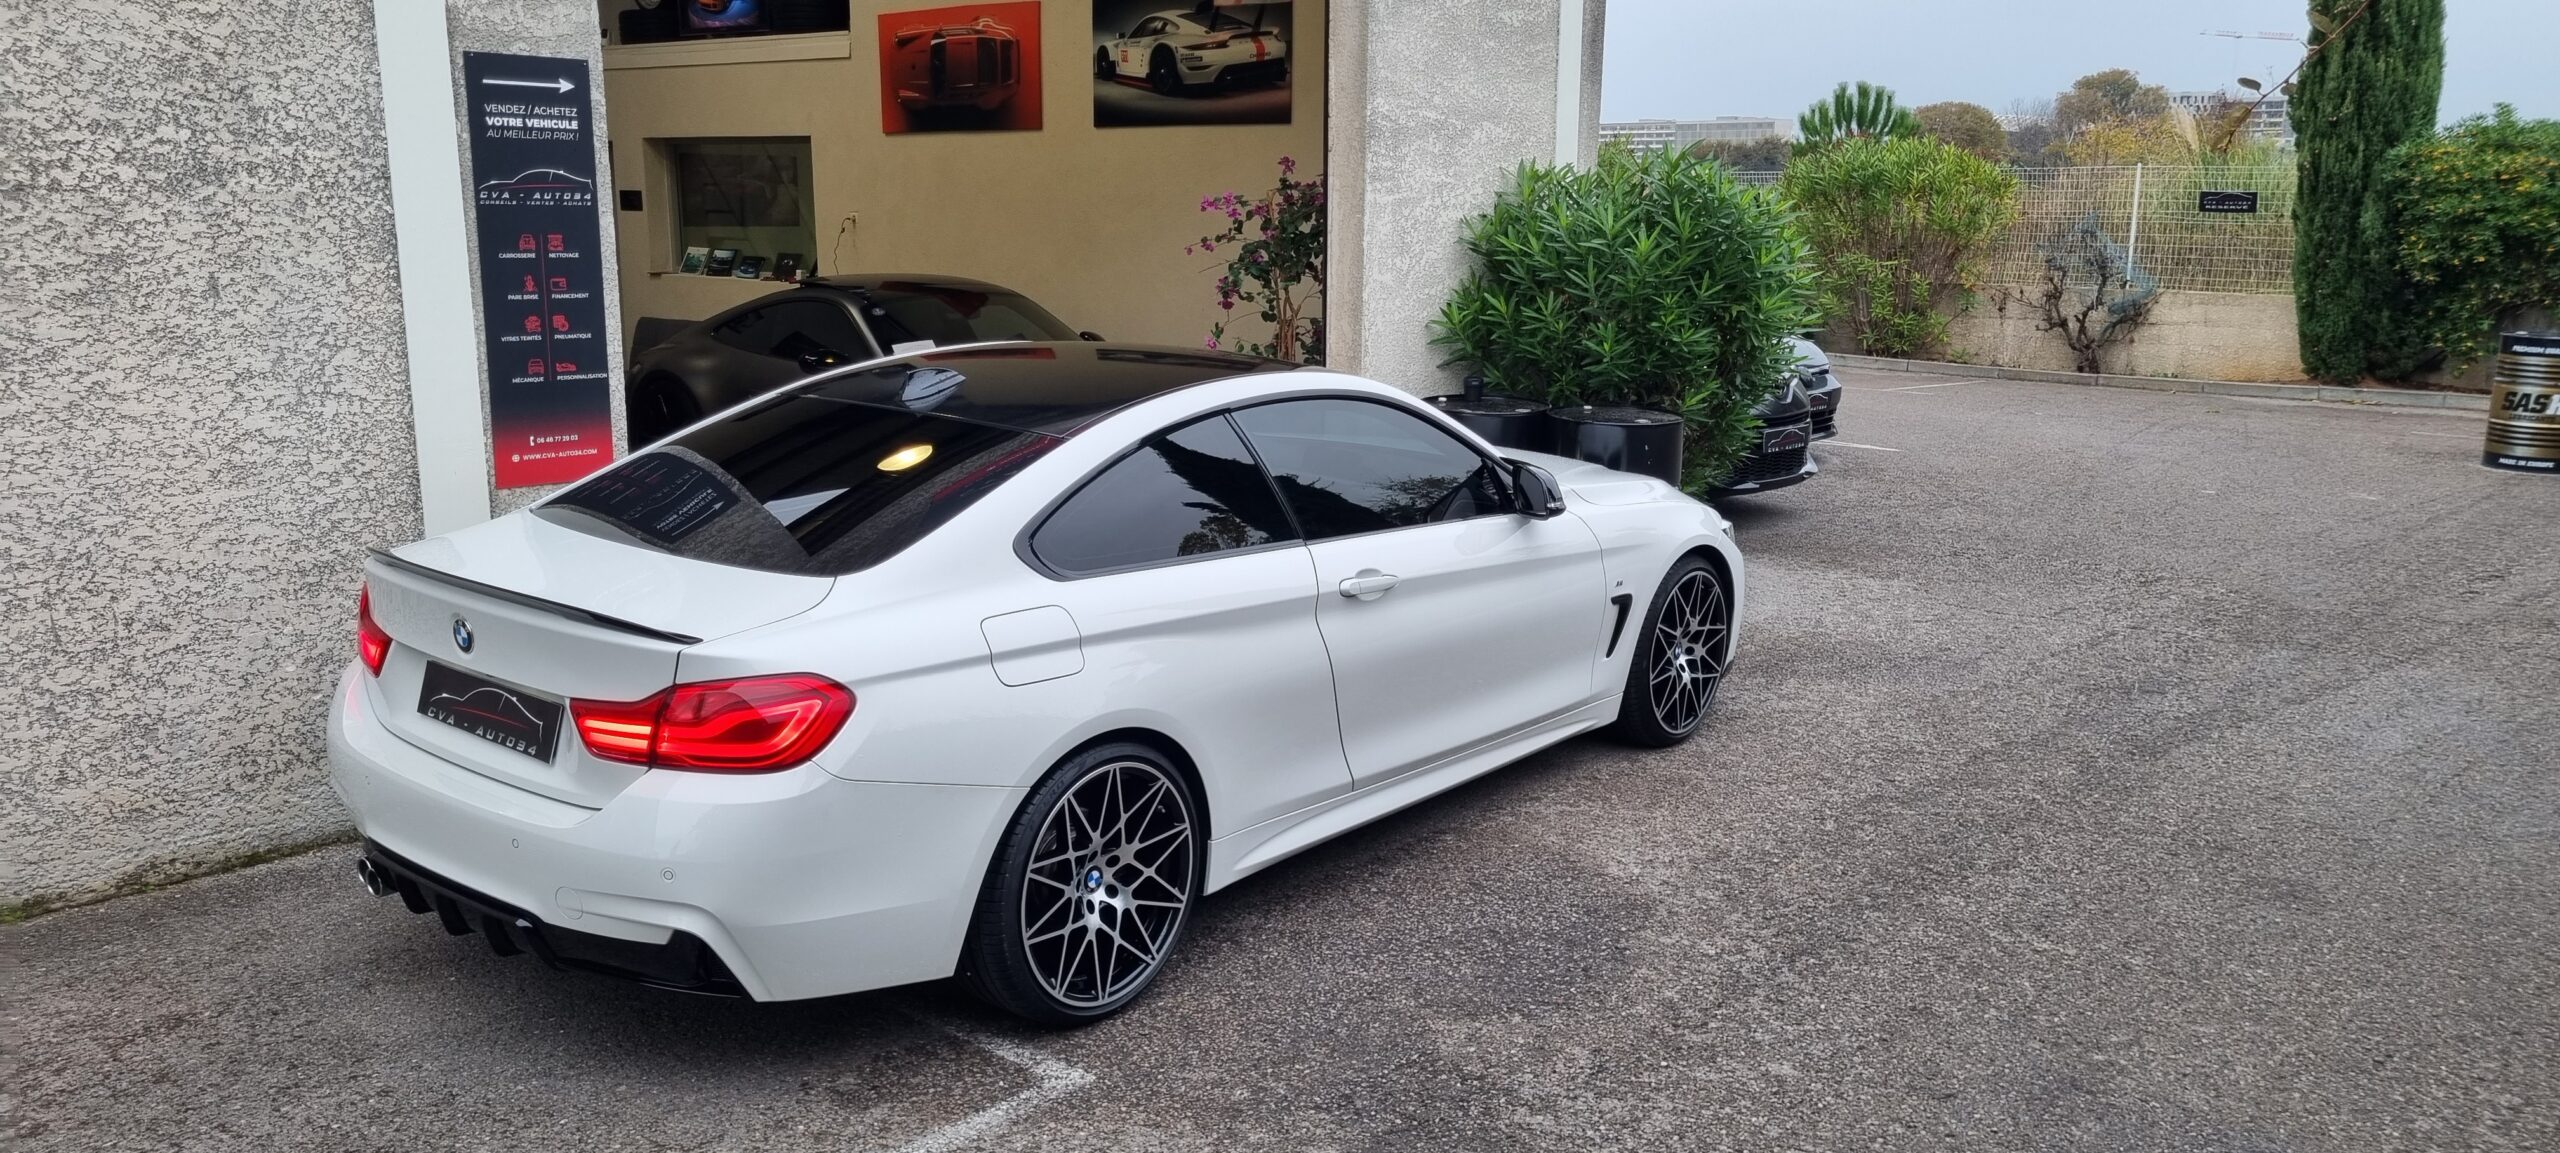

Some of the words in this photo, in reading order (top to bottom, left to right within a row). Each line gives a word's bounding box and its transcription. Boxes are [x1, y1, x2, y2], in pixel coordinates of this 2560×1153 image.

[484, 103, 526, 115] VENDEZ
[527, 104, 532, 115] /
[533, 106, 578, 117] ACHETEZ
[485, 116, 523, 127] VOTRE
[525, 118, 579, 130] VEHICULE
[486, 128, 501, 138] AU
[503, 129, 552, 140] MEILLEUR
[480, 191, 510, 199] CVA
[557, 373, 607, 381] PERSONNALISATION
[523, 448, 598, 461] WWW.CVA-AUTO34.COM
[427, 706, 455, 726] CVA
[475, 726, 537, 756] AUTO34
